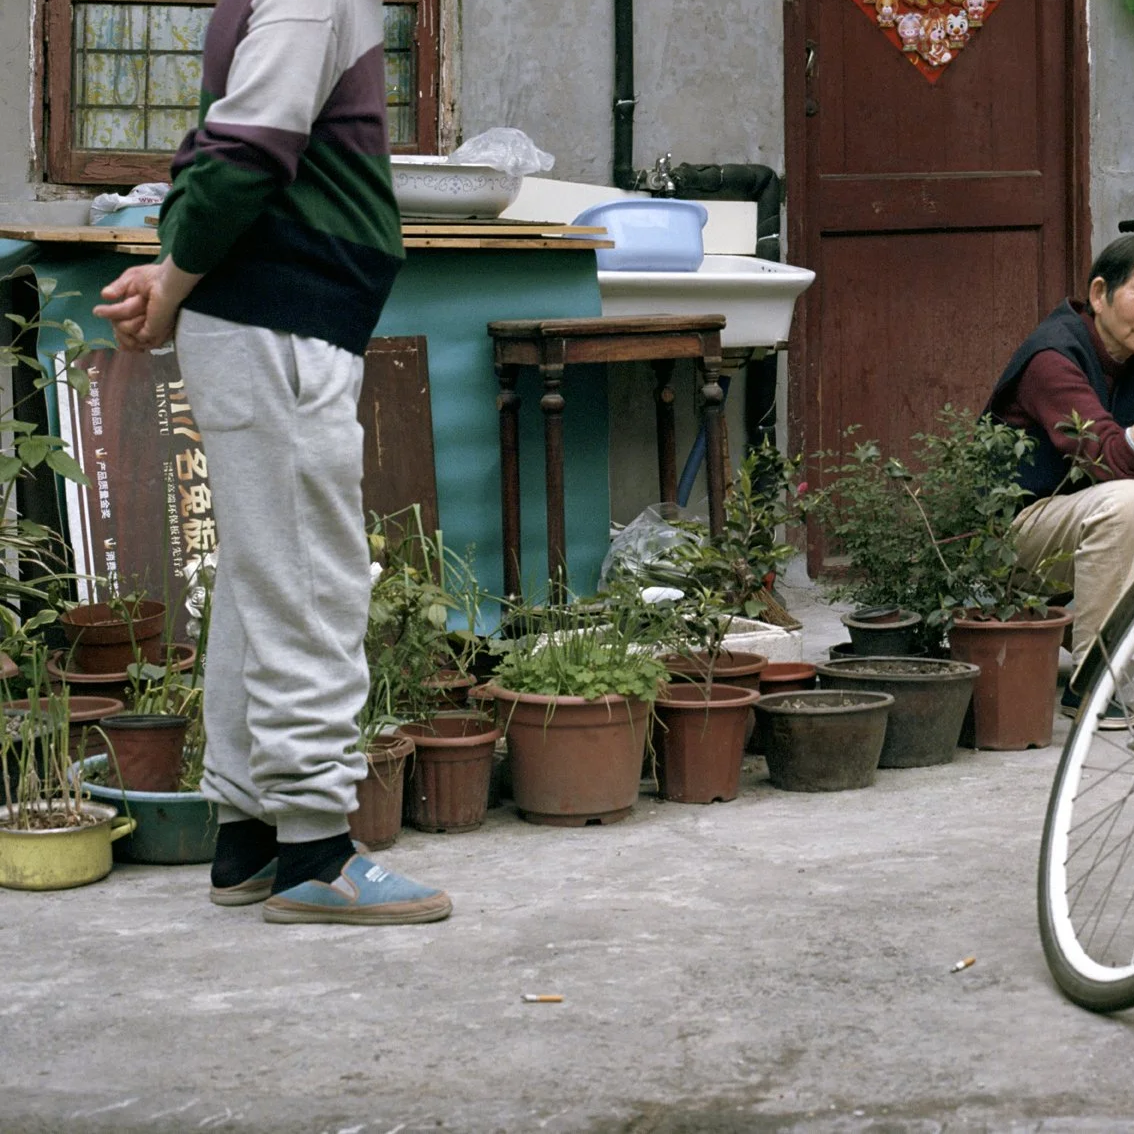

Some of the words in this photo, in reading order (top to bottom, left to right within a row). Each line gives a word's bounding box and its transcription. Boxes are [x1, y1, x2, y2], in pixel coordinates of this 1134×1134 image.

[155, 382, 170, 437] MINGTU
[175, 447, 218, 566] 名兔板
